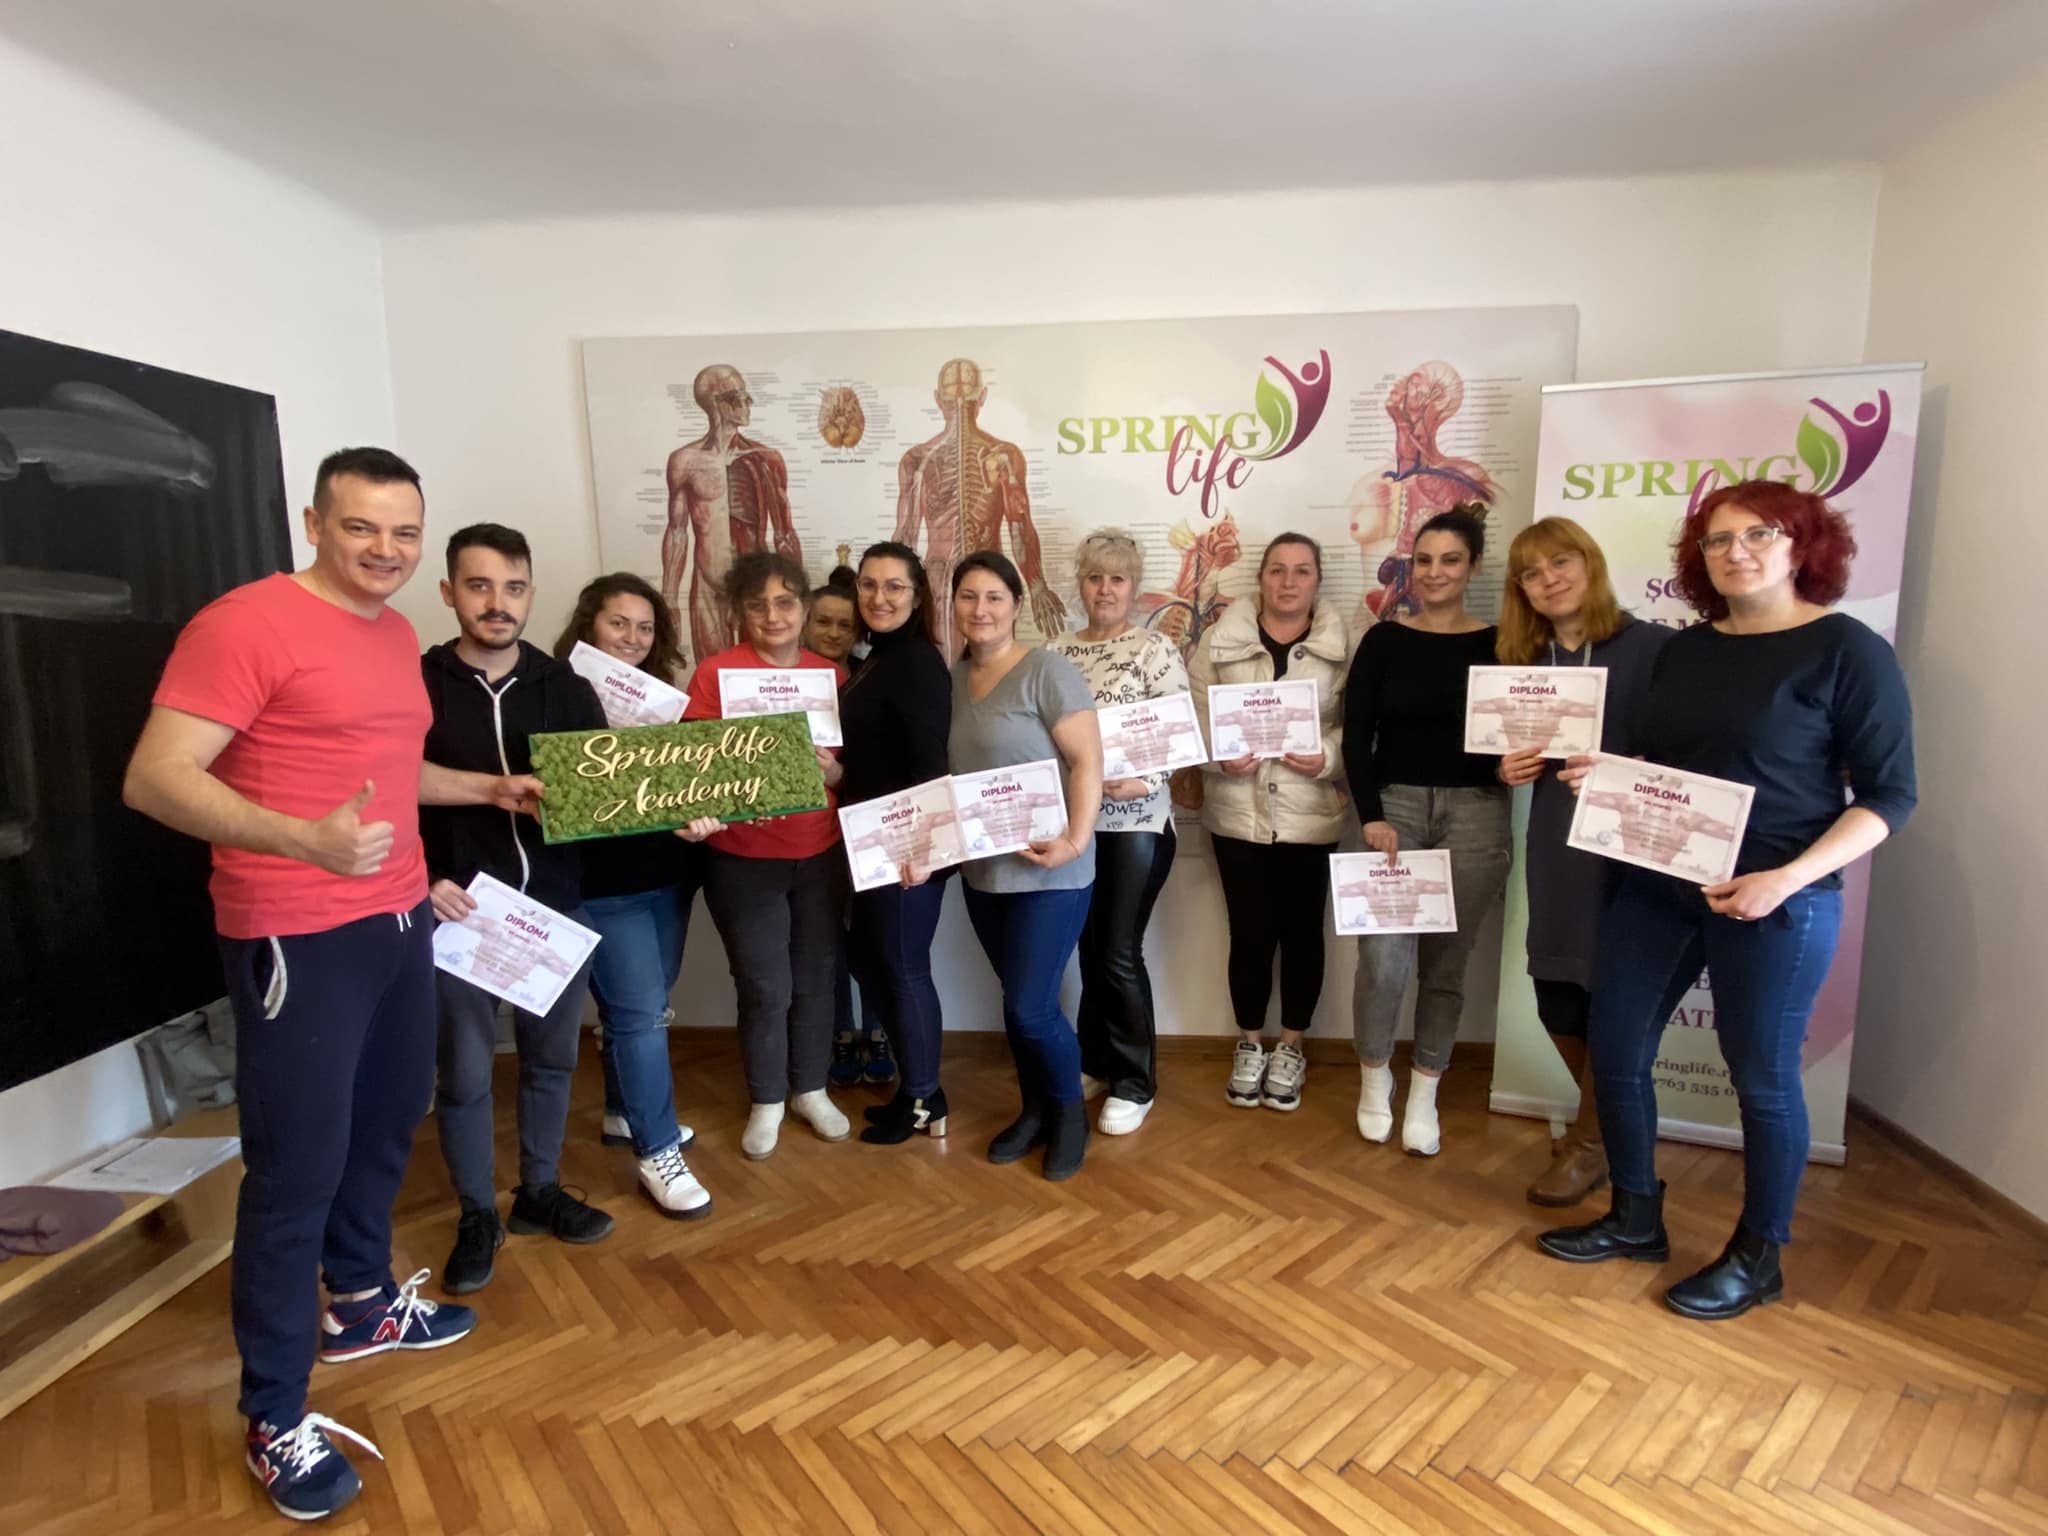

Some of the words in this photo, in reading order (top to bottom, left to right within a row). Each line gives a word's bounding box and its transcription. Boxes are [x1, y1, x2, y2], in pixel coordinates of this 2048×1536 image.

[1057, 412, 1261, 455] SPRING
[1166, 424, 1254, 519] life
[1562, 454, 1798, 500] SPRING
[576, 725, 781, 780] Springlife
[593, 775, 769, 823] Academy
[1633, 782, 1692, 806] DIPLOMĂ
[504, 912, 551, 943] DIPLOMĂ
